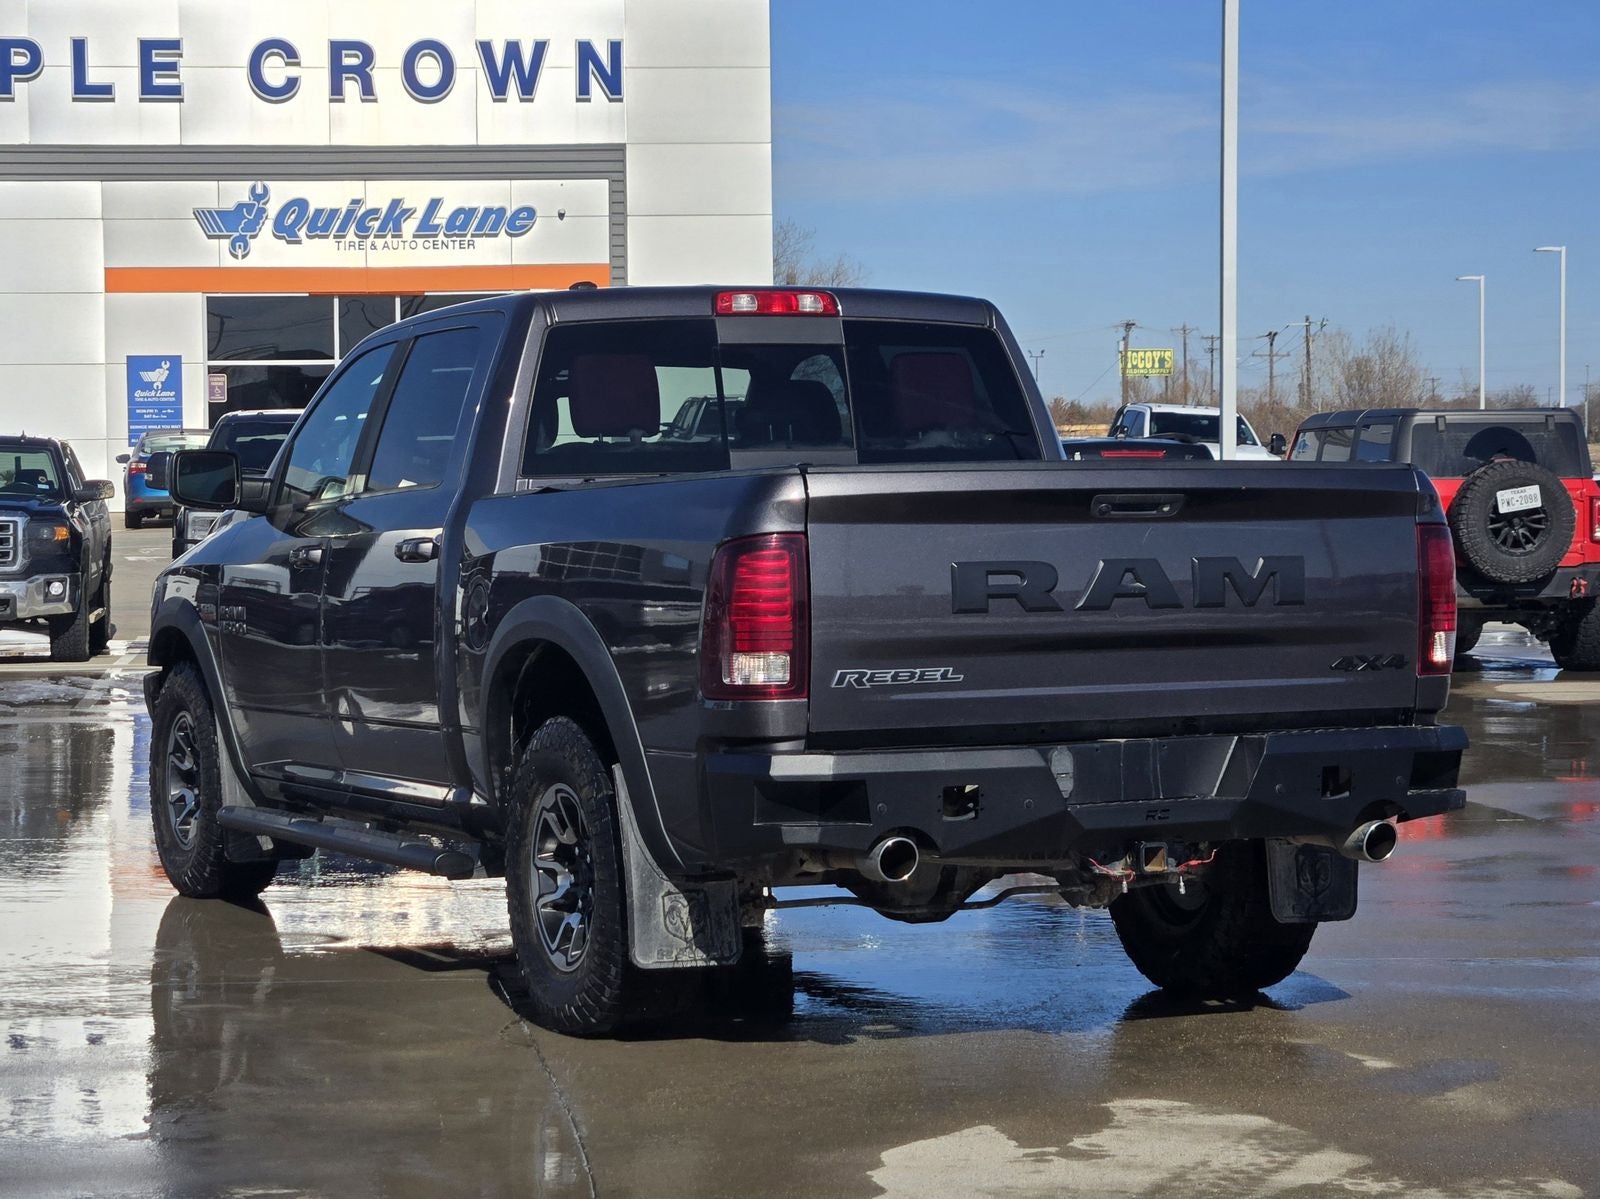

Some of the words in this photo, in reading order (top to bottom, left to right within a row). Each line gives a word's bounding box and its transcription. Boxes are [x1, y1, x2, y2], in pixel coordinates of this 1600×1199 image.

[0, 36, 184, 103] PLE
[247, 37, 624, 105] CROWN
[272, 197, 416, 244] Quick
[413, 196, 538, 238] Lane
[334, 240, 366, 252] TIRE
[369, 240, 379, 251] &
[381, 239, 419, 251] AUTO
[422, 239, 476, 250] CENTER
[134, 390, 156, 398] Quick
[950, 555, 1305, 614] RAM
[830, 667, 964, 688] REBEL
